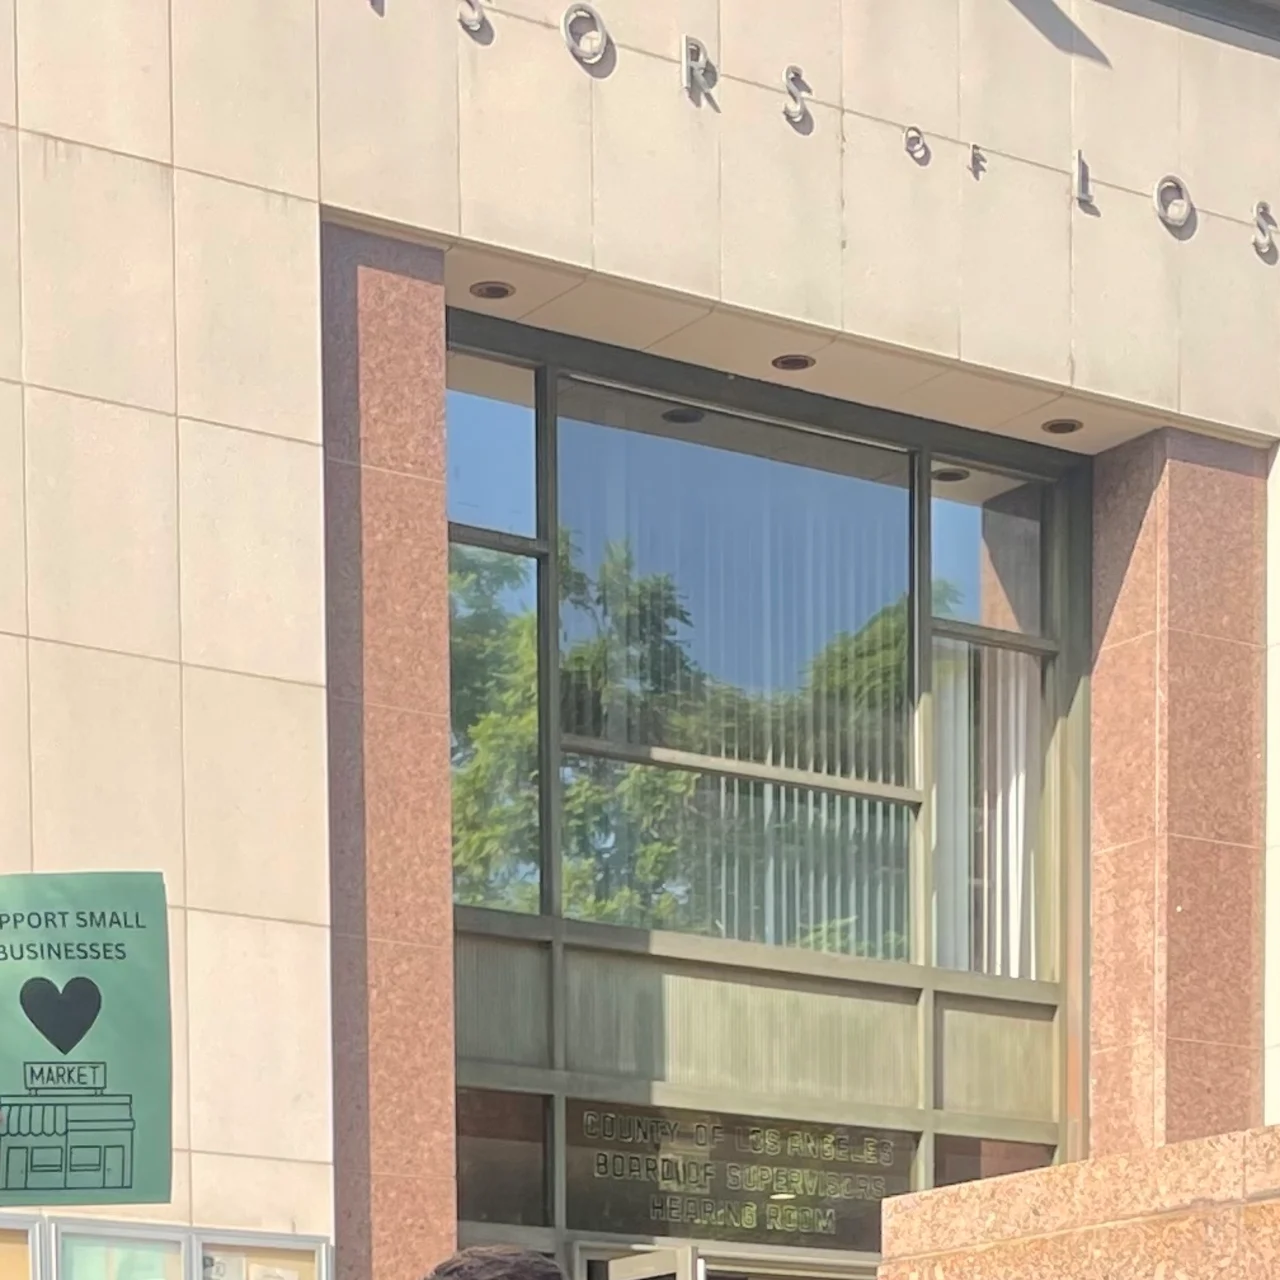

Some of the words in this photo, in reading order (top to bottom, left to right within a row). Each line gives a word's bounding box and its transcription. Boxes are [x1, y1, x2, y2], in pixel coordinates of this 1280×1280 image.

[903, 125, 987, 168] OF
[1072, 149, 1280, 256] LOS
[75, 911, 147, 929] SMALL
[29, 1065, 100, 1085] MARKET
[582, 1110, 680, 1145] COUNTY
[694, 1123, 725, 1149] OF
[735, 1125, 783, 1156] LOS
[786, 1130, 895, 1167] ANGELES
[593, 1151, 675, 1185] BOARD
[686, 1159, 716, 1186] OF
[726, 1162, 887, 1200] SUPERVISORS
[649, 1195, 758, 1229] HEARING
[766, 1204, 836, 1235] ROOM
